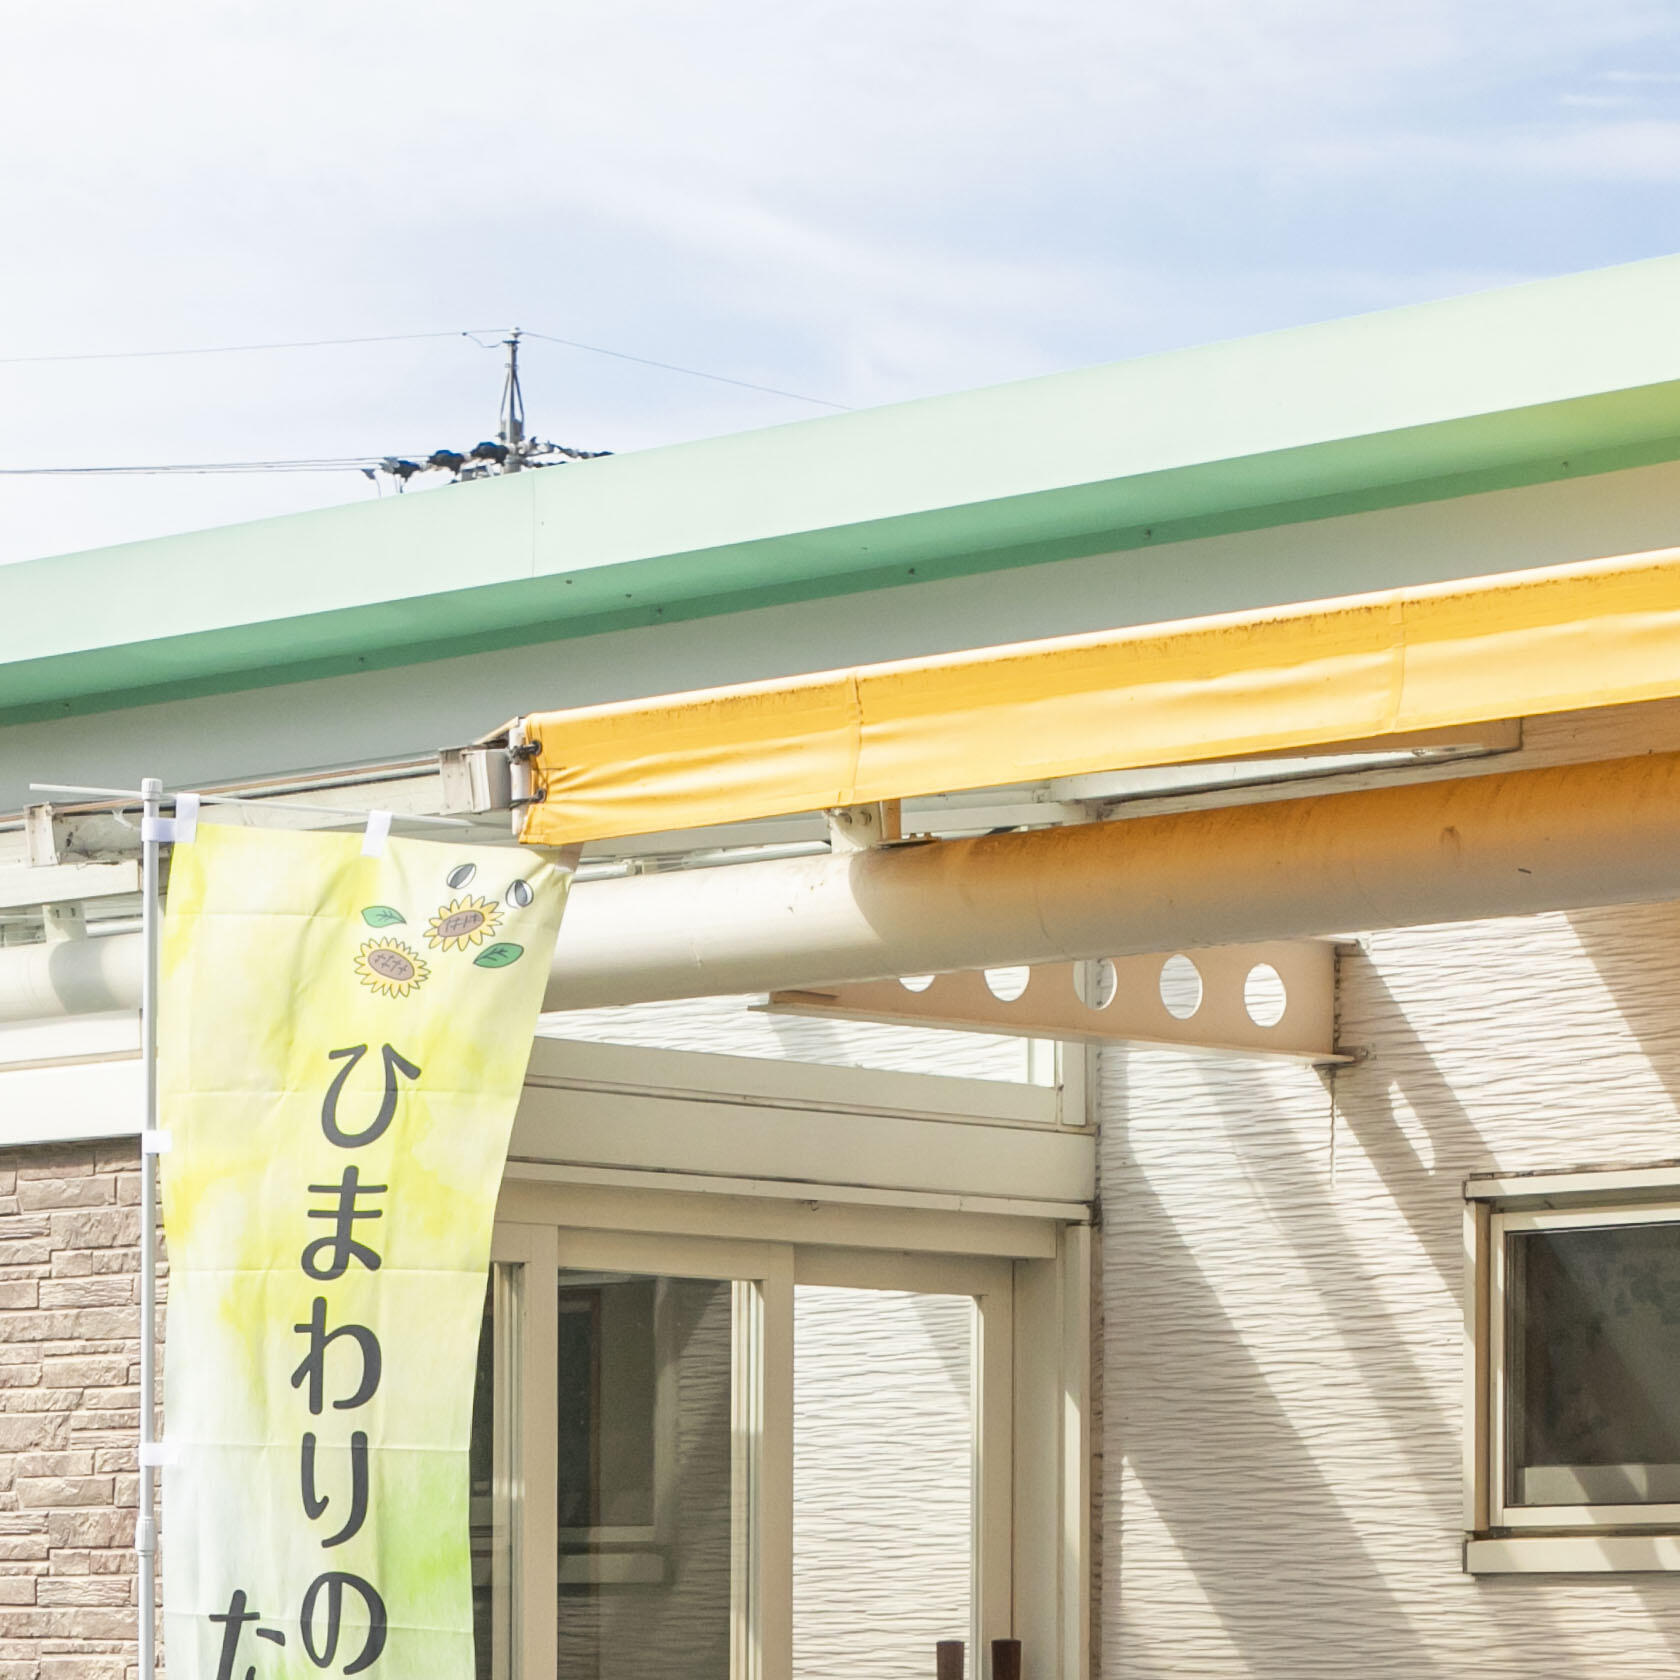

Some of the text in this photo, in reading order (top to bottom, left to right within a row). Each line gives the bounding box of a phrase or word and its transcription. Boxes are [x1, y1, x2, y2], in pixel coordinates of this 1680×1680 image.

[290, 1043, 421, 1676] ひまわりの
